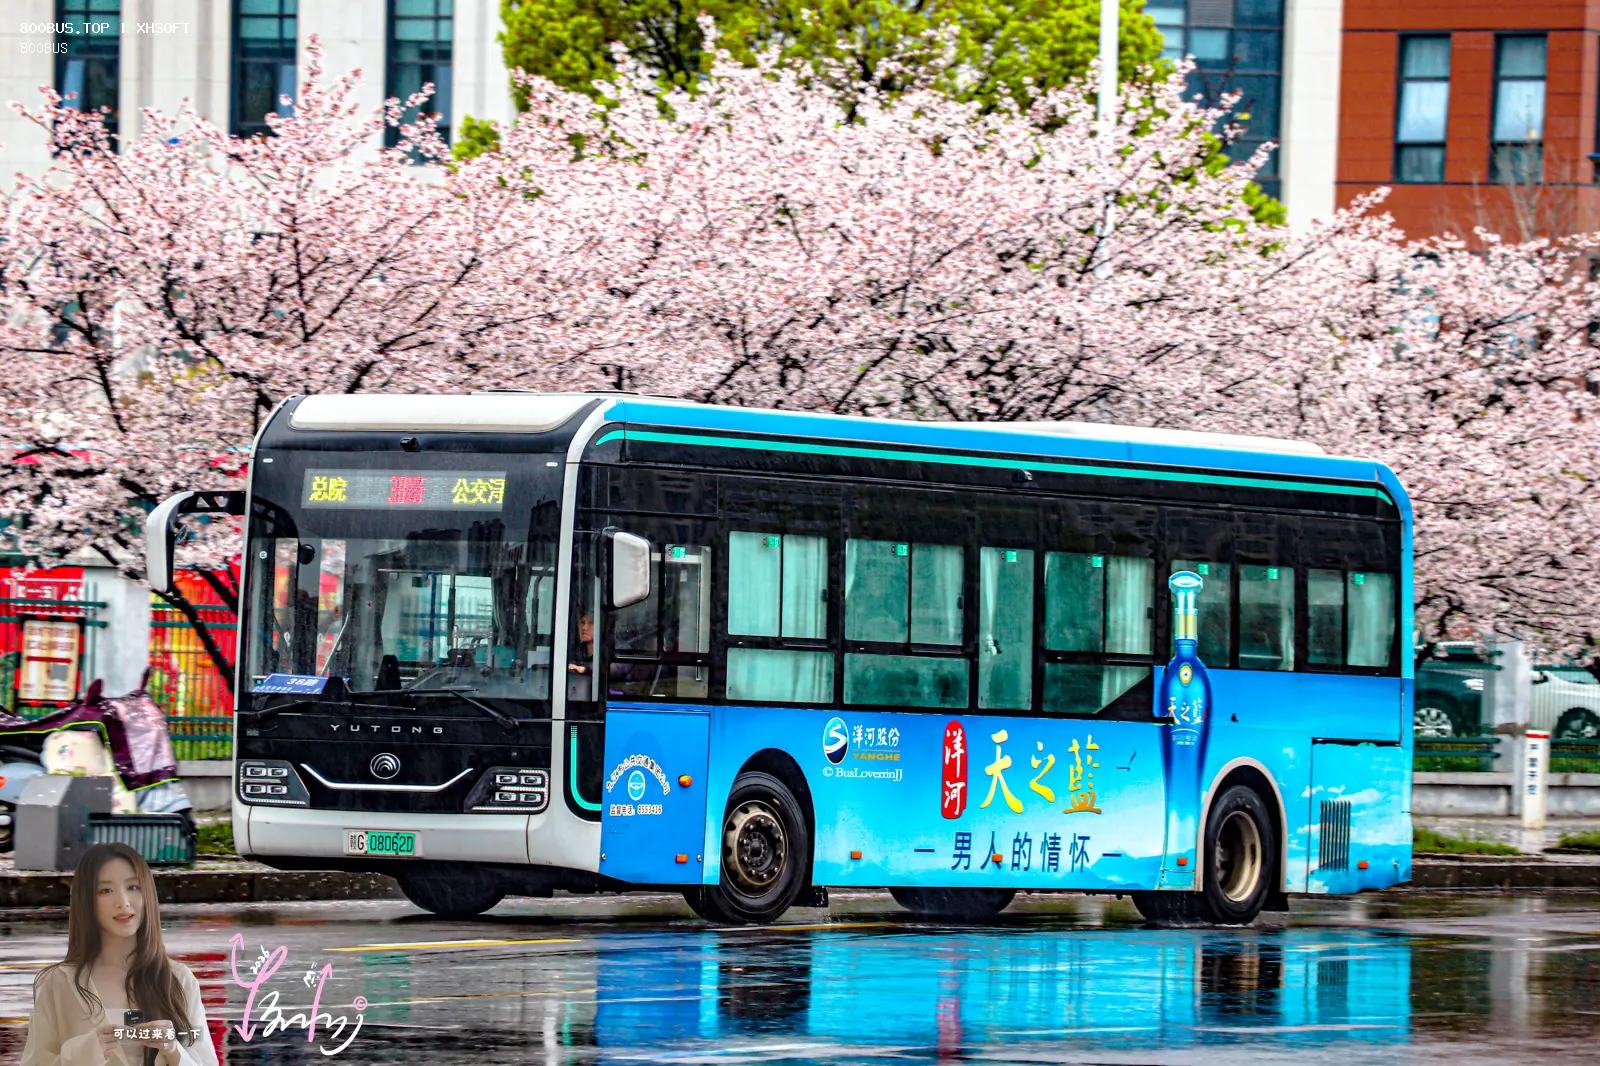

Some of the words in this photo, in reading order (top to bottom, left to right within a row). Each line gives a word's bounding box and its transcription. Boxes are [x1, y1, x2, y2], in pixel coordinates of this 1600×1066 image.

[309, 476, 347, 501] 总院
[330, 724, 443, 734] YUTONG
[852, 725, 900, 748] 洋河股份
[853, 752, 900, 762] YANGHE
[944, 728, 966, 815] 洋河
